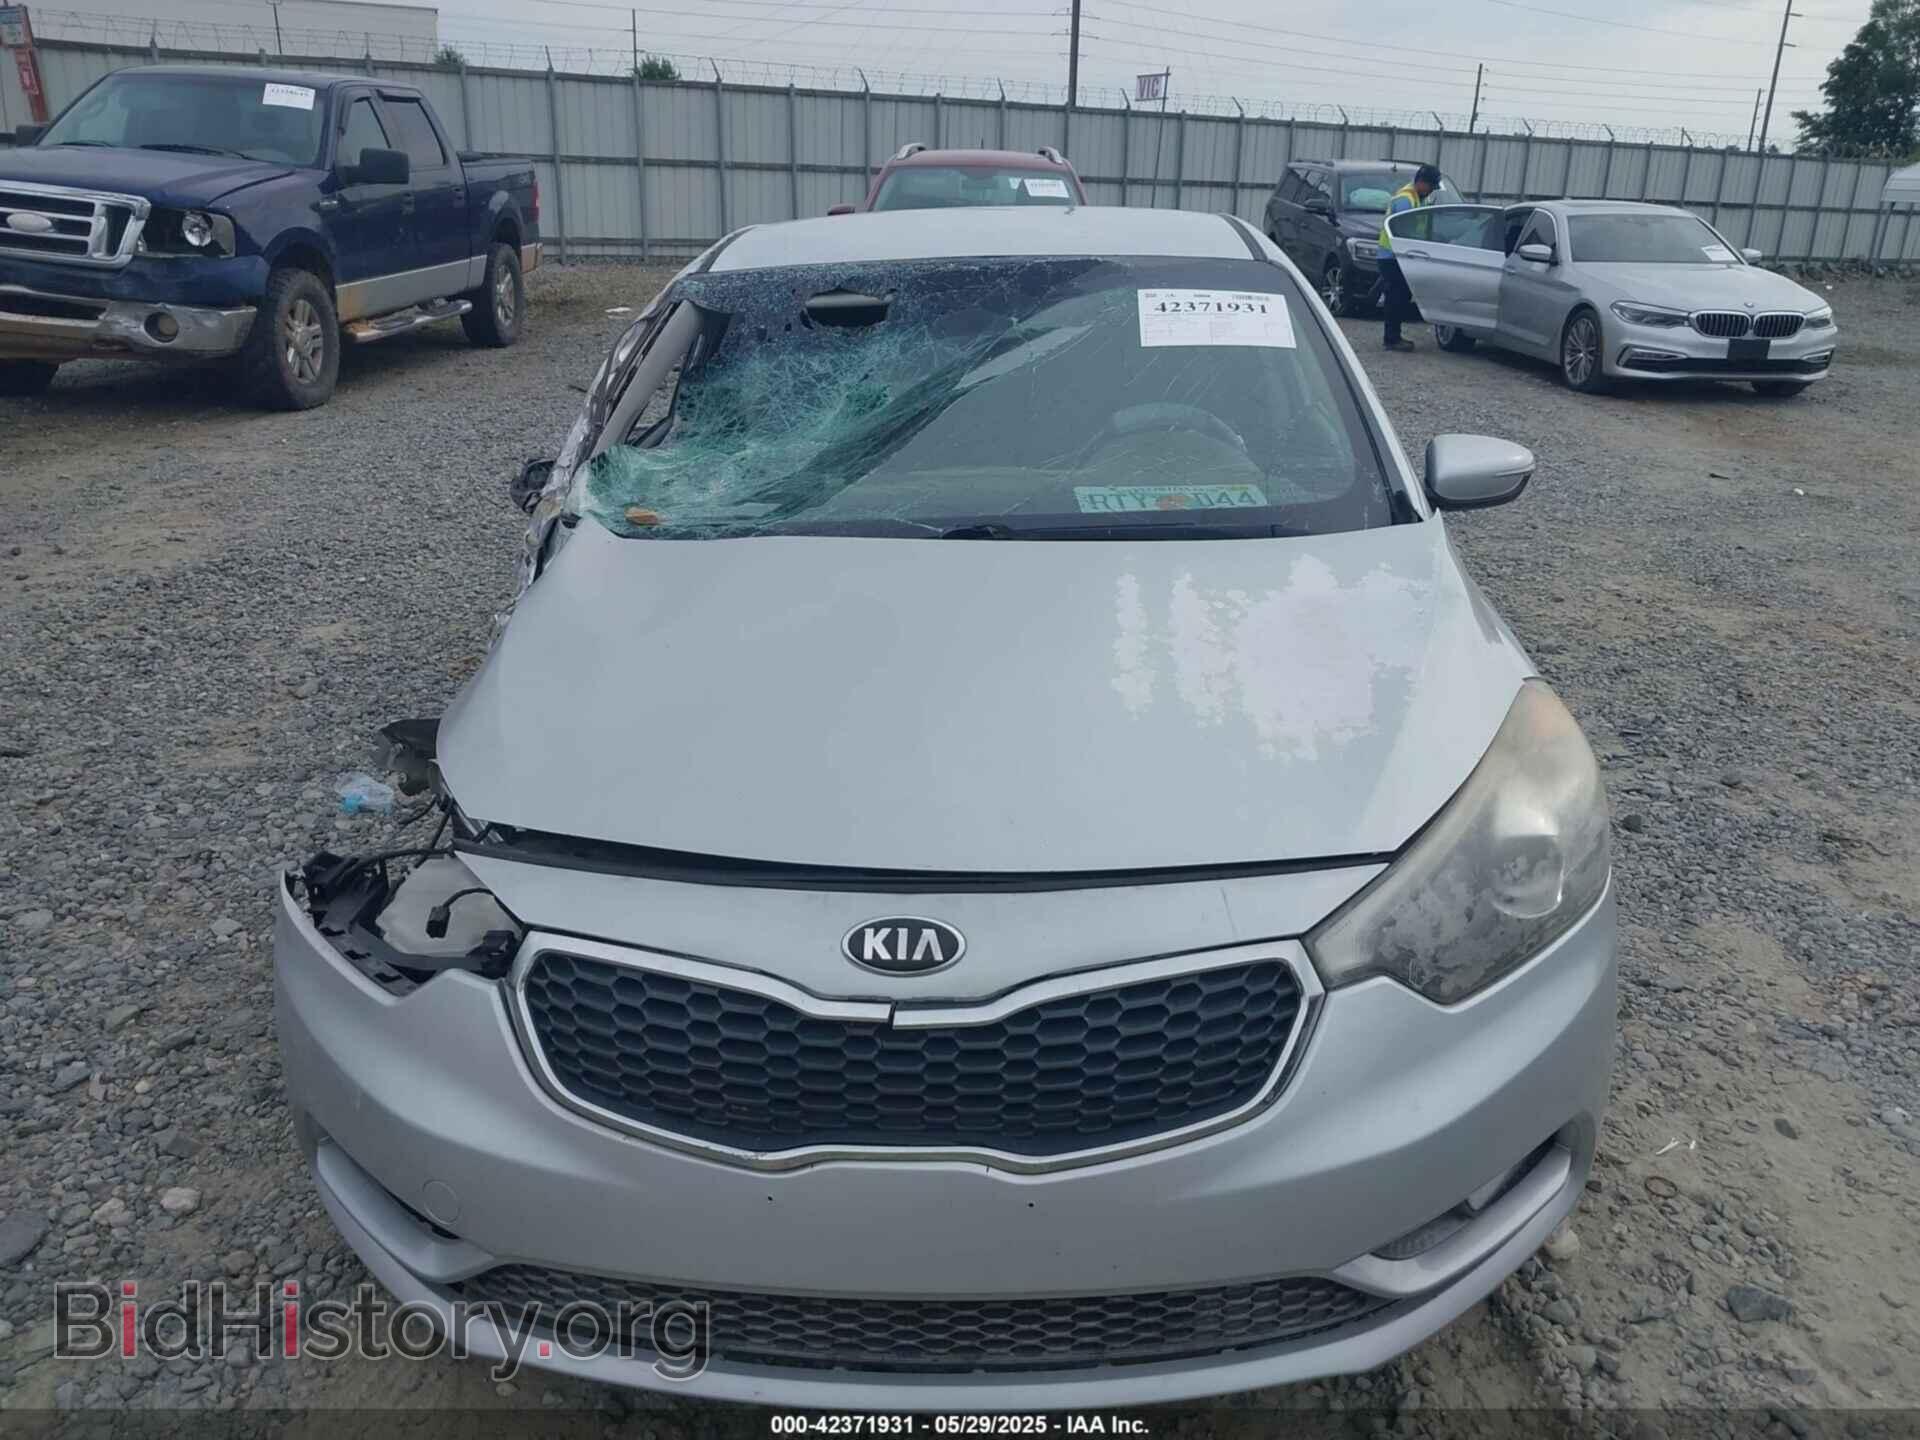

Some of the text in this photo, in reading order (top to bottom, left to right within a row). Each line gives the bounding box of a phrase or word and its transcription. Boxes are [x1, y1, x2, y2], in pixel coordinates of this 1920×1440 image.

[1139, 77, 1159, 97] VIC
[1153, 301, 1269, 314] 42371931
[1089, 490, 1148, 512] RTY
[863, 927, 944, 961] KIA
